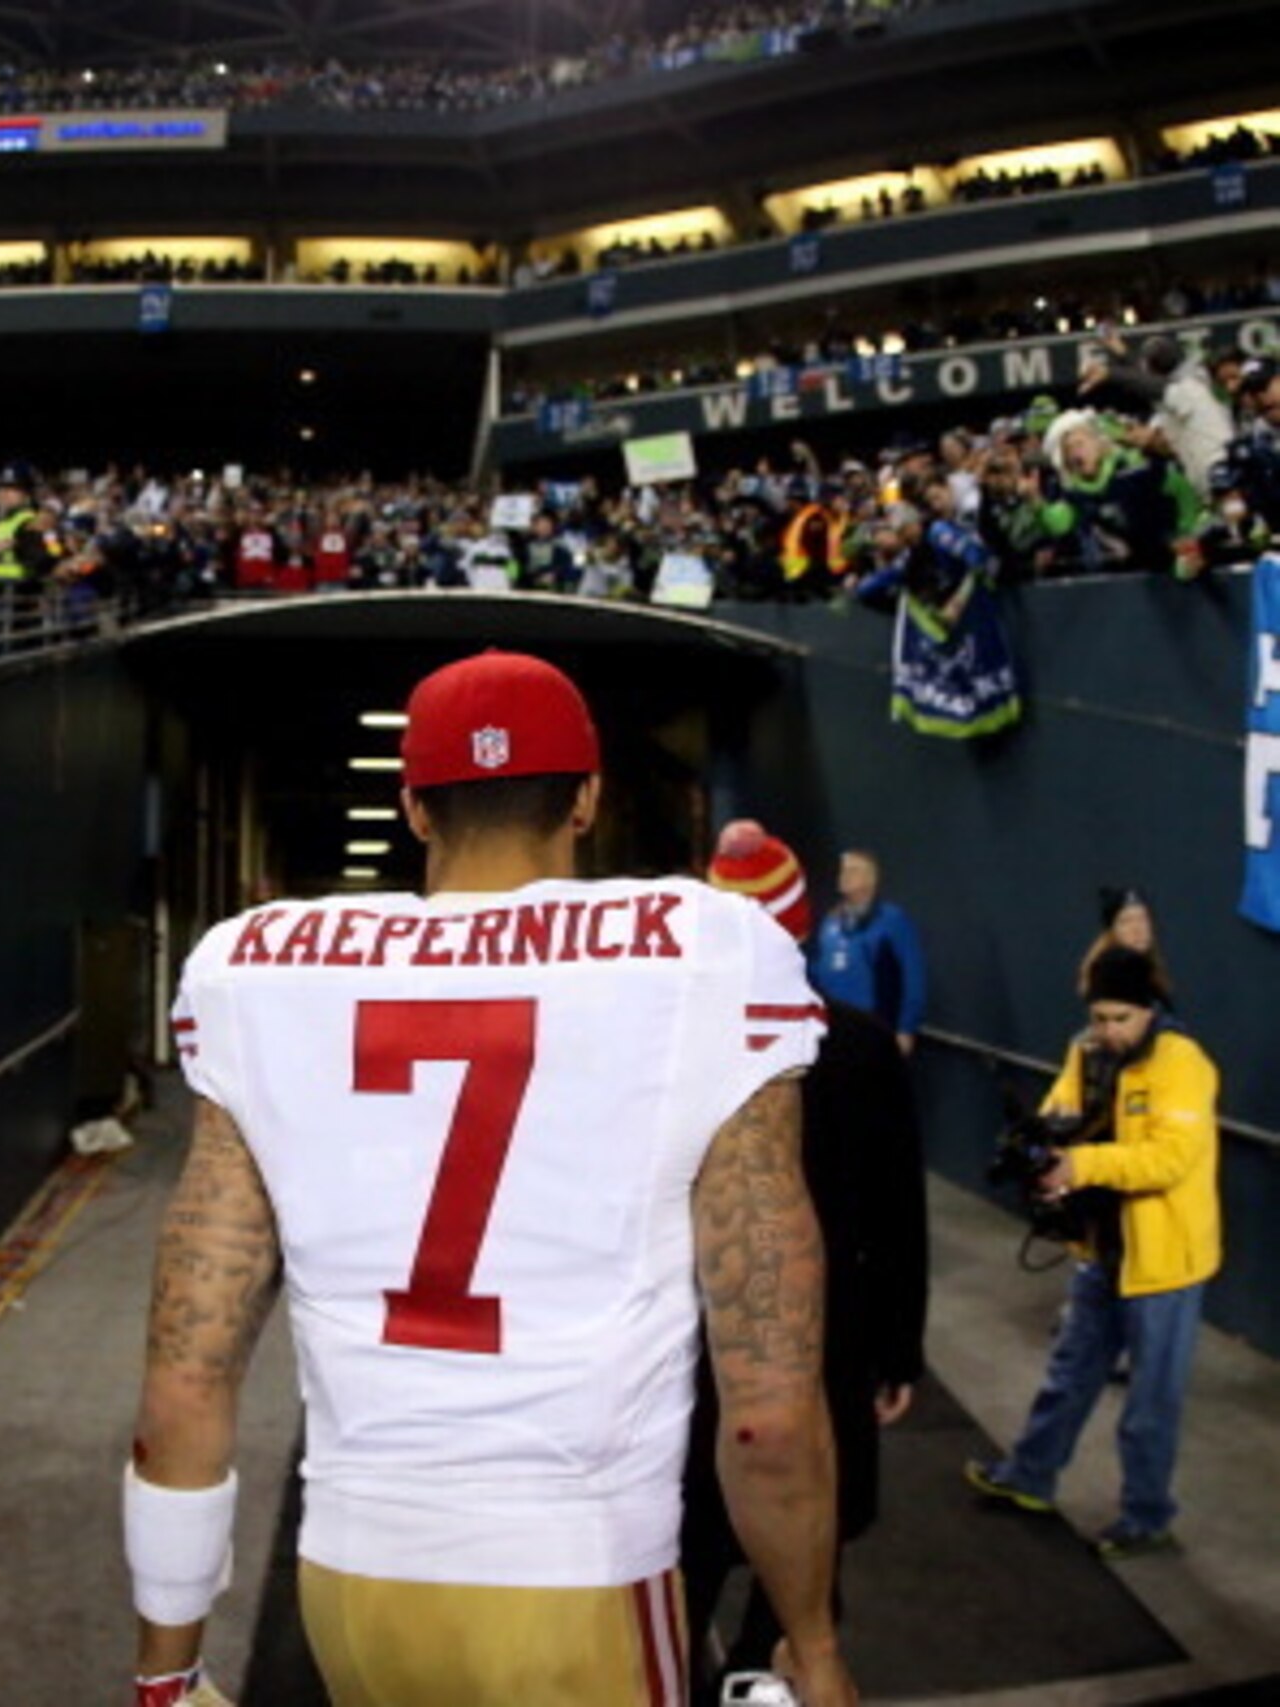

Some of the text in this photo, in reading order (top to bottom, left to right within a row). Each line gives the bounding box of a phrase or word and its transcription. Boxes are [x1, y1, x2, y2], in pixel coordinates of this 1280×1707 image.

[701, 341, 1110, 429] WELCOME
[228, 893, 683, 967] KAEPERNICK
[352, 996, 539, 1355] 7
